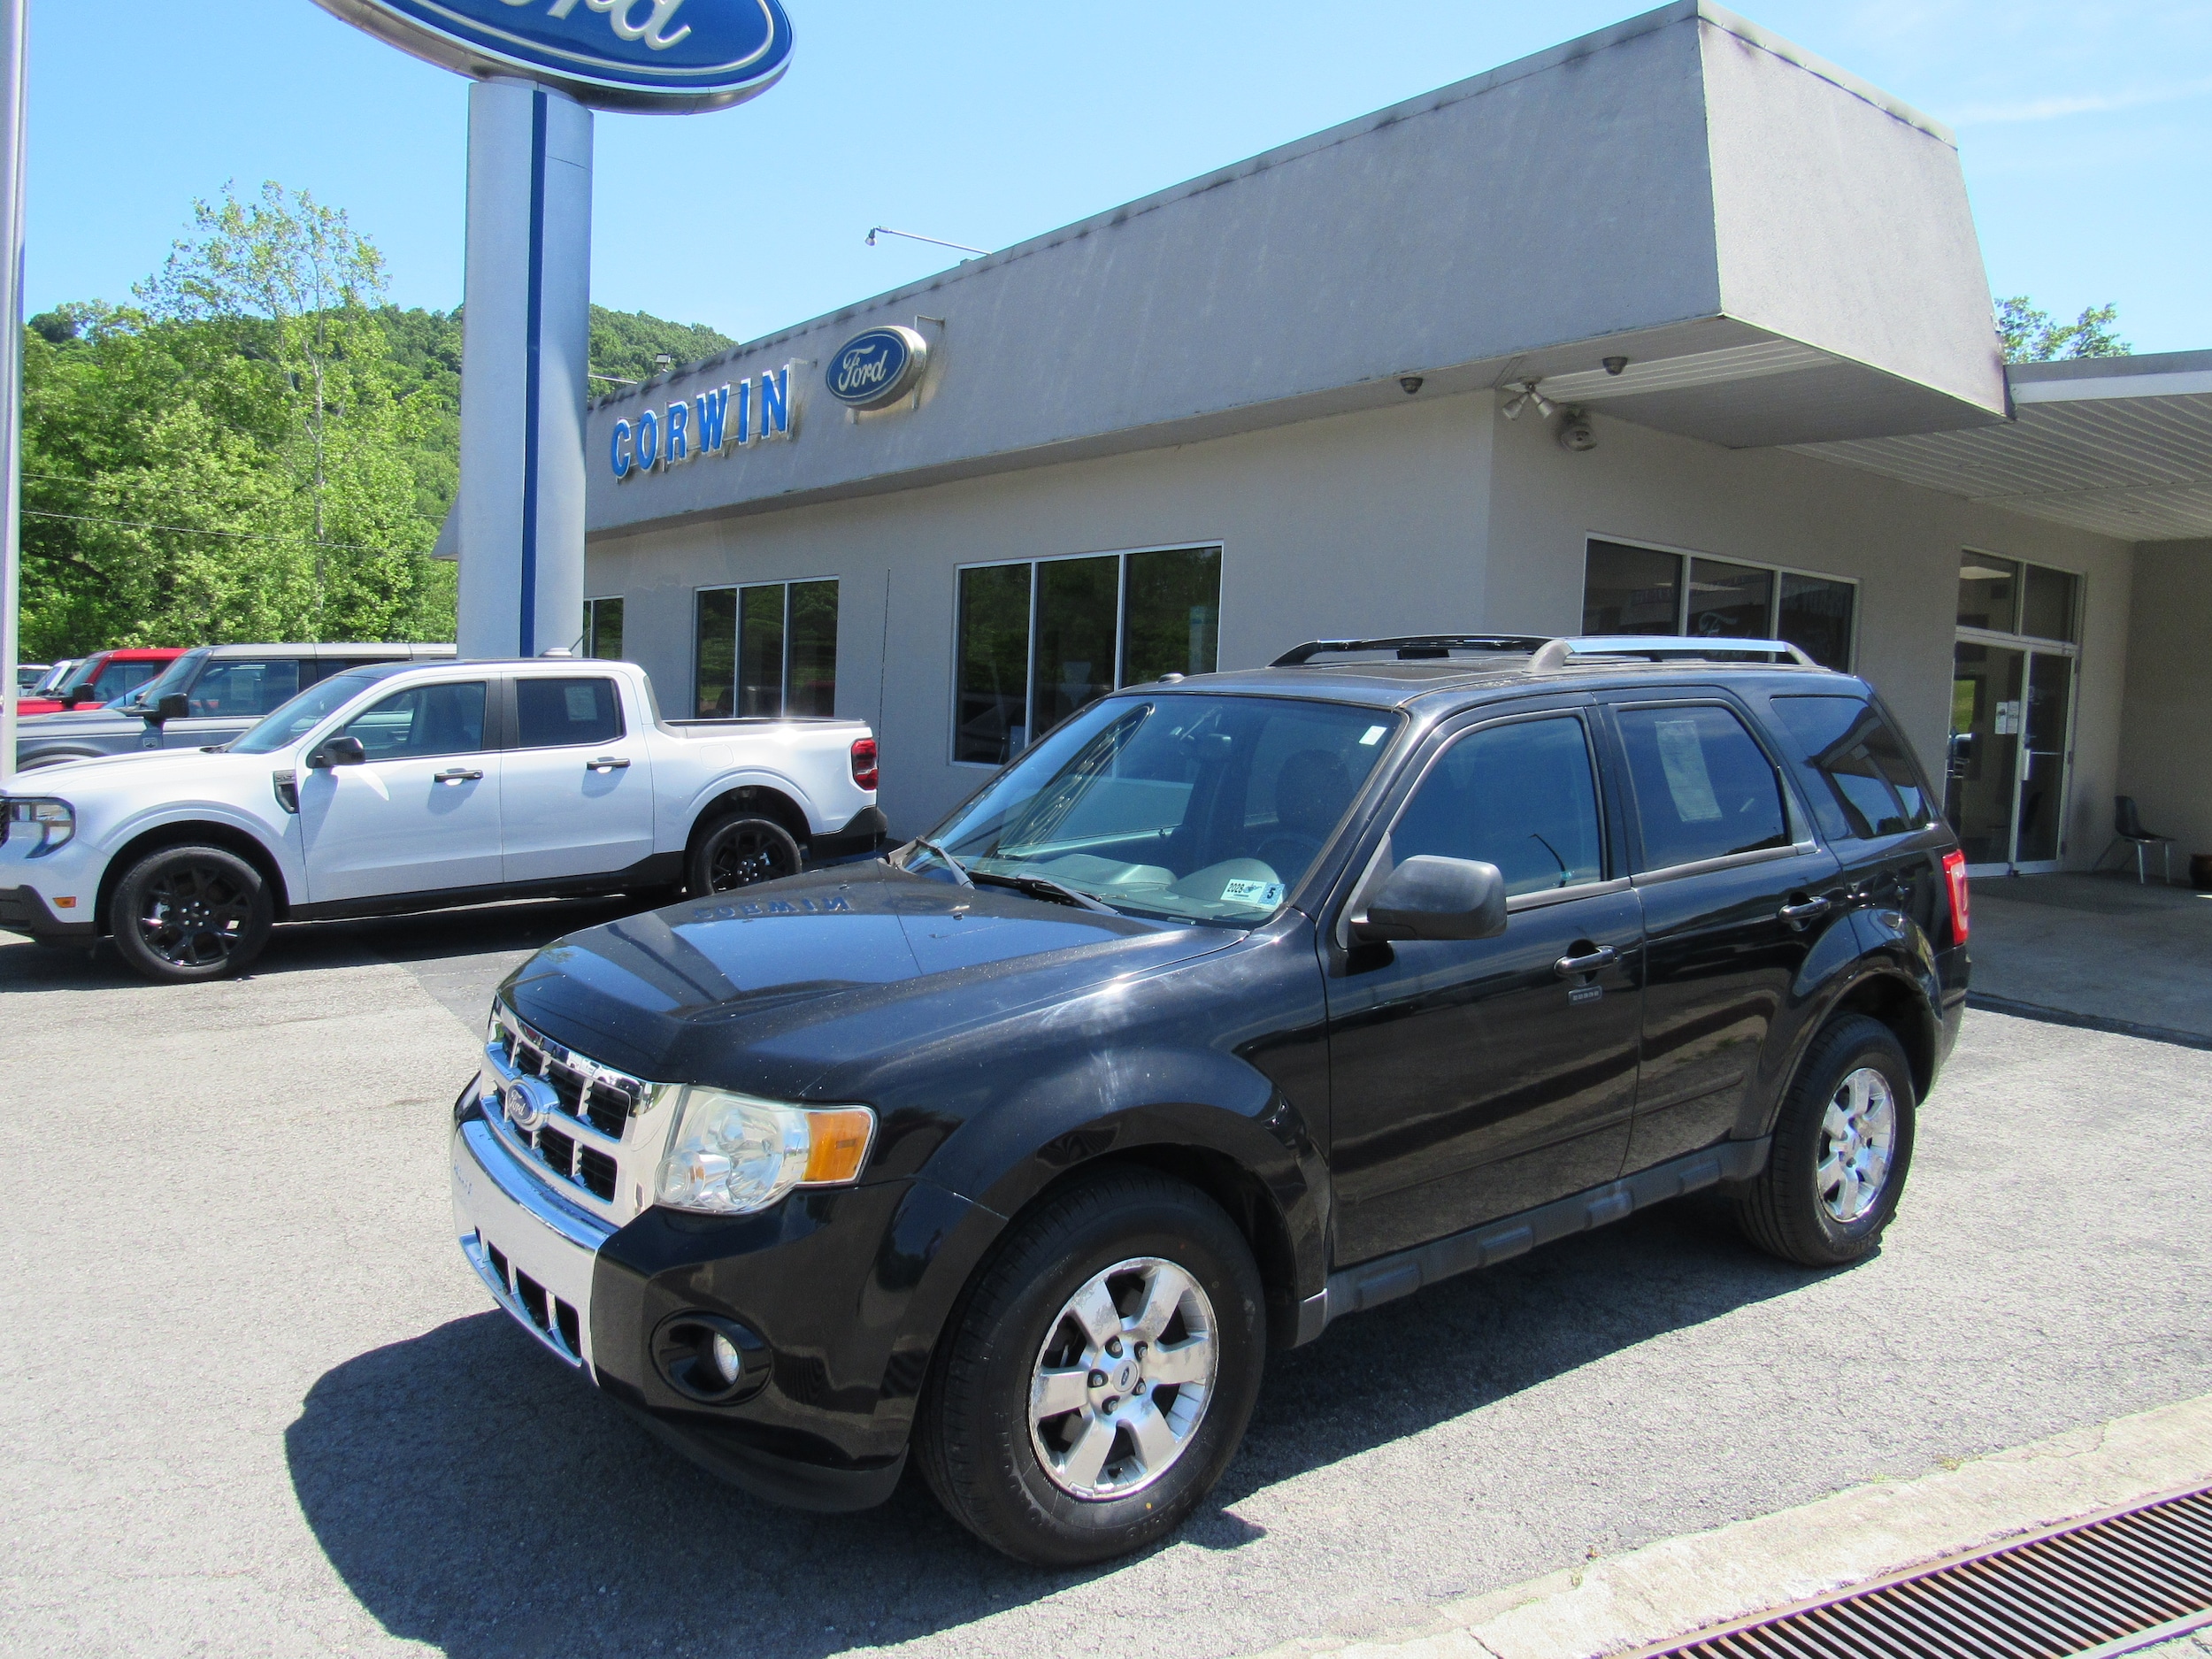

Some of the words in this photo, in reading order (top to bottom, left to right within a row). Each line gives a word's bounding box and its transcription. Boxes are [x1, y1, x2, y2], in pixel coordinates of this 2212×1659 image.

[838, 344, 888, 391] Ford
[611, 365, 789, 479] CORWIN
[1267, 887, 1276, 899] 5
[509, 1089, 526, 1116] Ford
